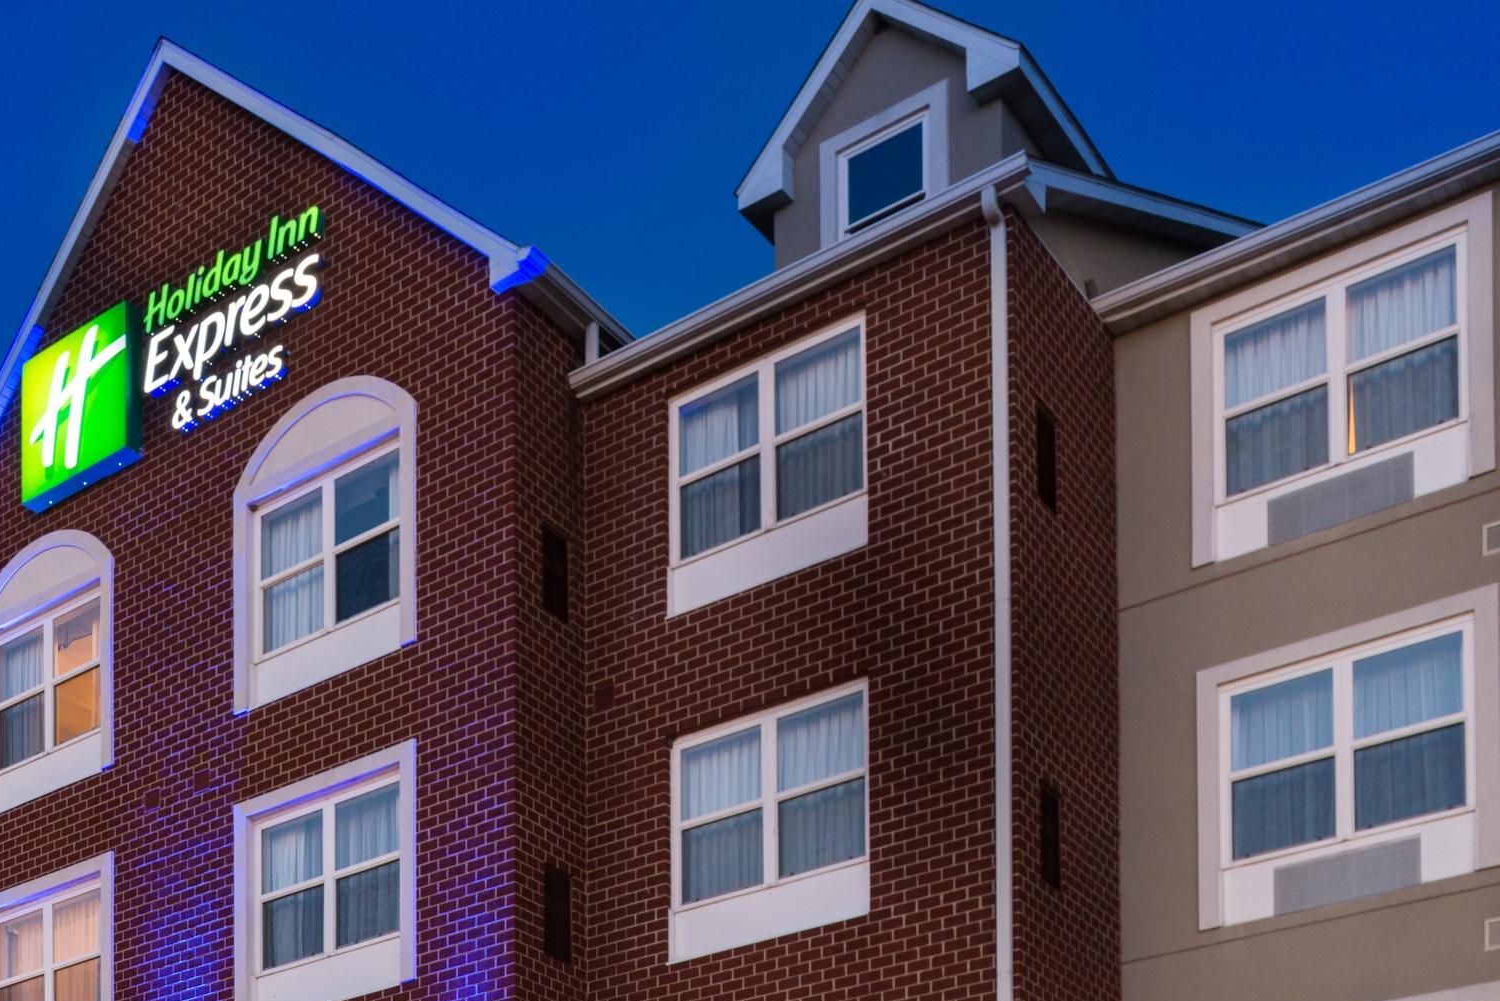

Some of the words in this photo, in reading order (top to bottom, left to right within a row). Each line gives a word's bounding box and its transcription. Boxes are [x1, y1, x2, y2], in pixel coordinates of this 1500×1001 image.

[143, 239, 262, 334] Holiday
[268, 205, 319, 260] Inn
[144, 253, 319, 394] Express
[171, 389, 194, 430] &
[197, 345, 284, 417] Suites
